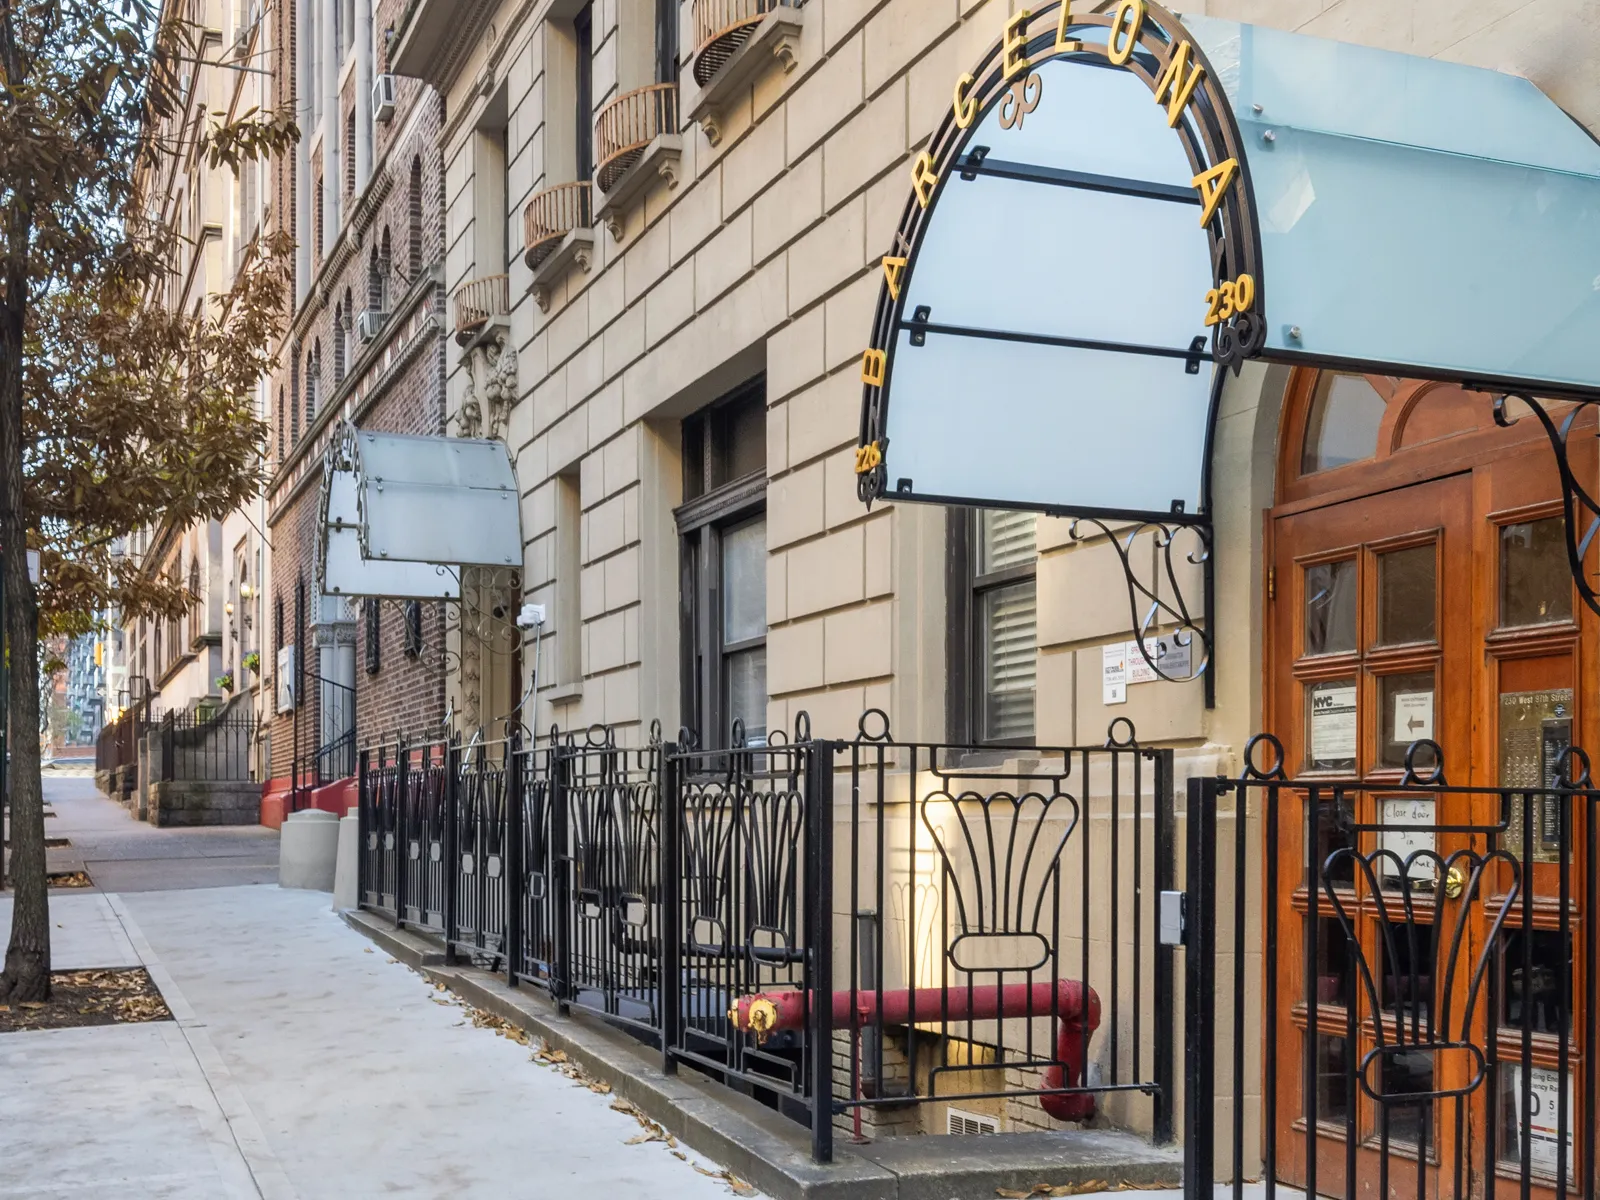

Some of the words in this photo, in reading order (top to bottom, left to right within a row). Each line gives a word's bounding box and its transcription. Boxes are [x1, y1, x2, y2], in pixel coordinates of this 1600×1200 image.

[1204, 273, 1254, 327] 230
[855, 440, 881, 473] 226
[1314, 696, 1333, 708] NYC
[1518, 696, 1533, 704] West
